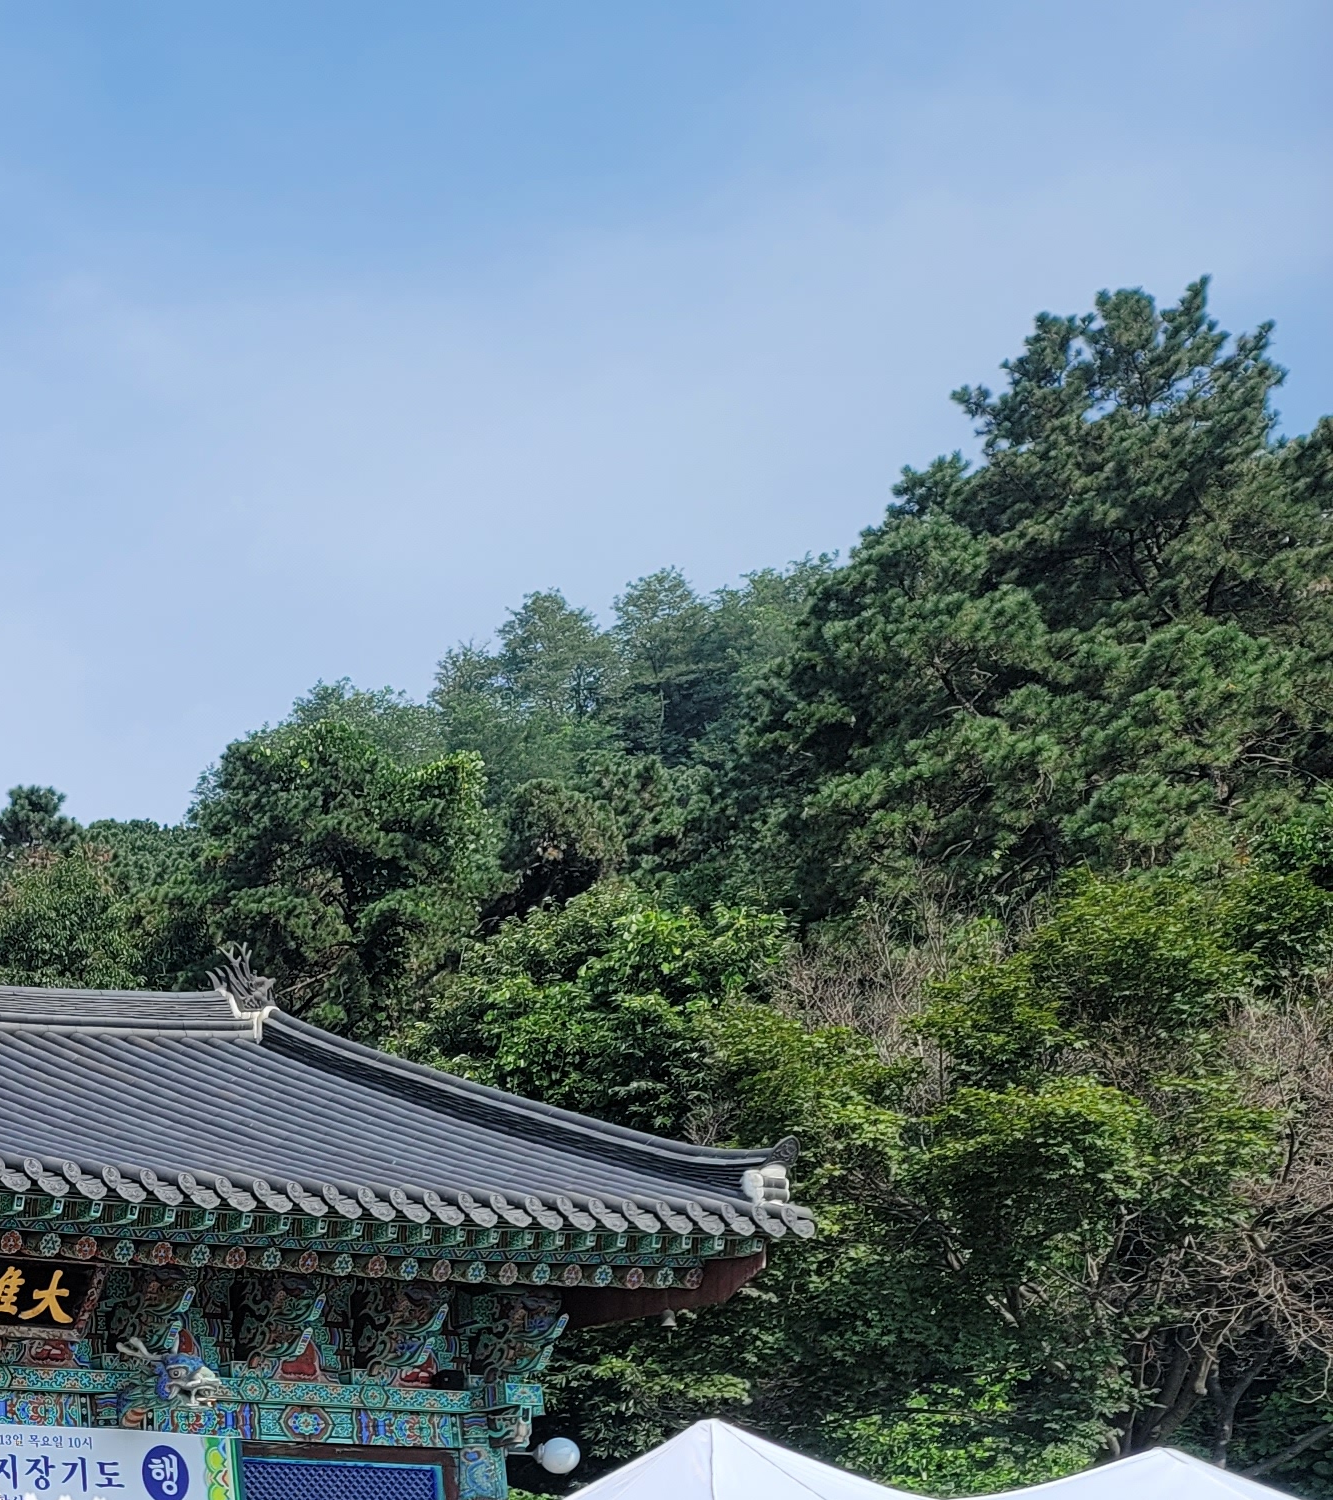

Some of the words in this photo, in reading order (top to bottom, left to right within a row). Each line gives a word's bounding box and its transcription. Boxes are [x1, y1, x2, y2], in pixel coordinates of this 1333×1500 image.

[0, 1433, 24, 1447] 13일
[27, 1434, 63, 1449] 목요일
[68, 1437, 93, 1450] 10시
[147, 1455, 179, 1495] 행
